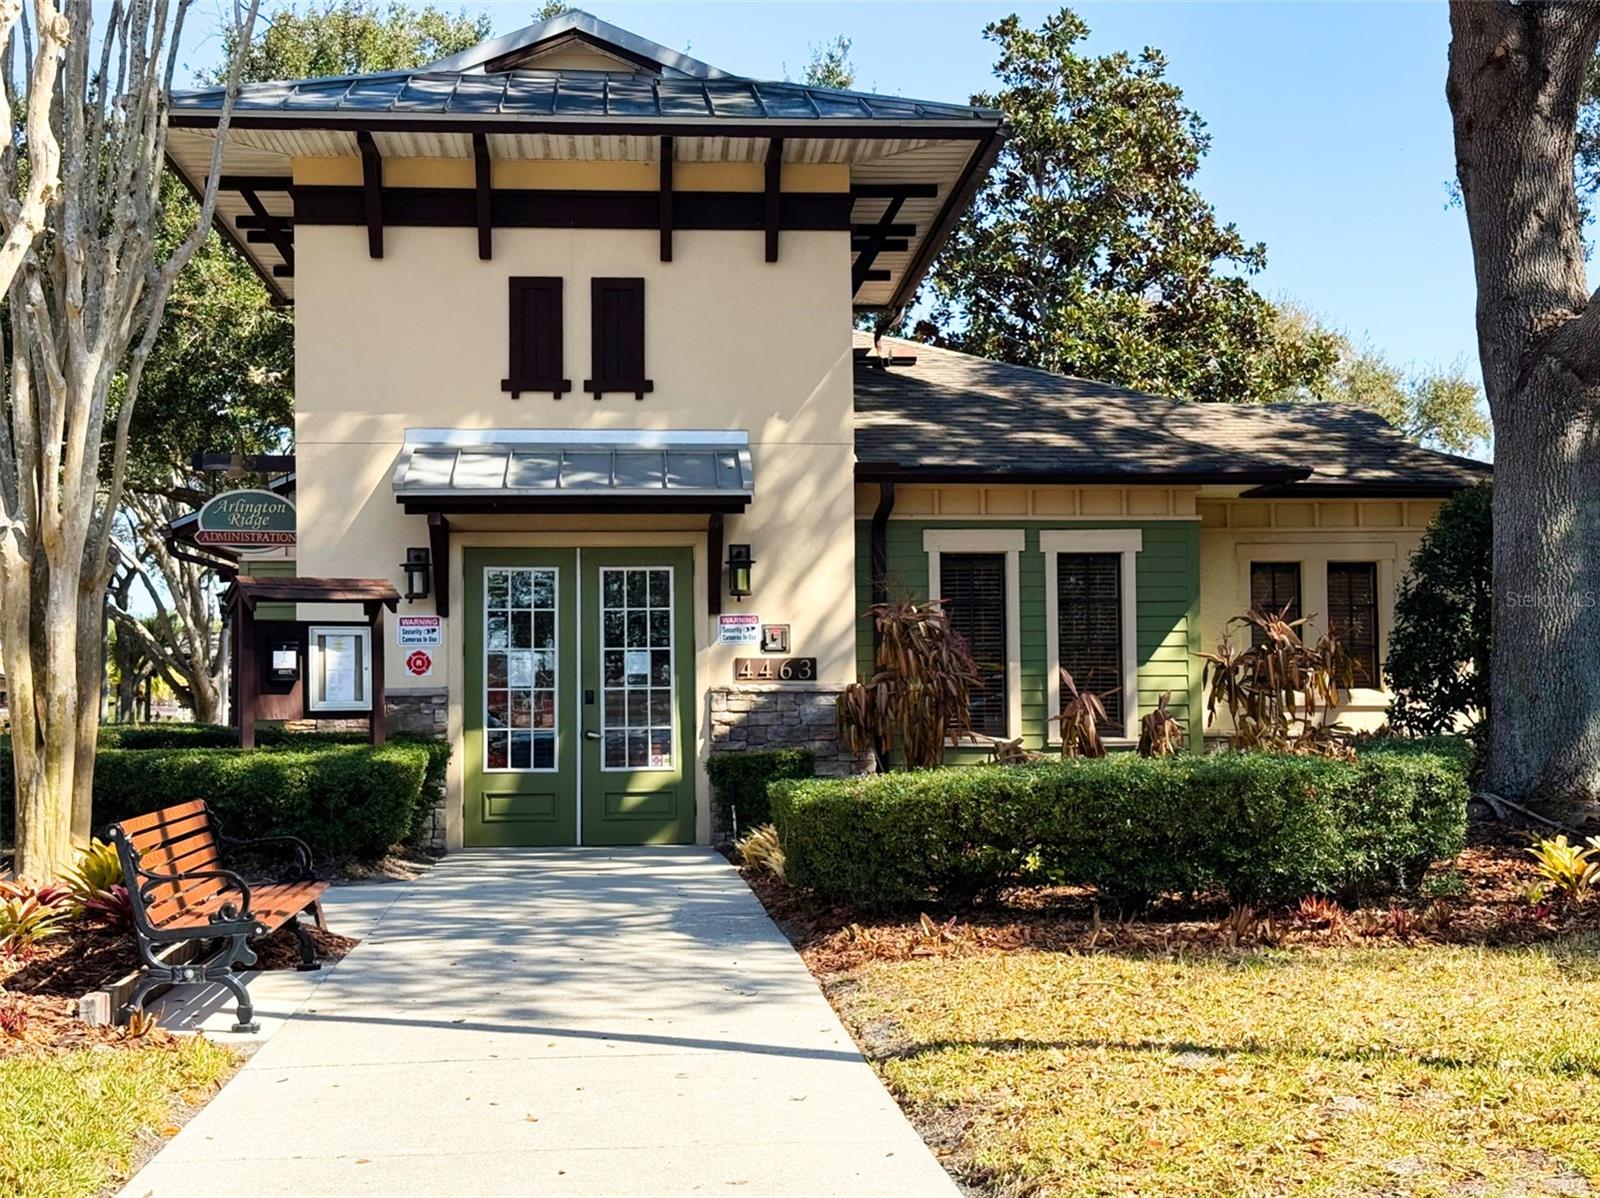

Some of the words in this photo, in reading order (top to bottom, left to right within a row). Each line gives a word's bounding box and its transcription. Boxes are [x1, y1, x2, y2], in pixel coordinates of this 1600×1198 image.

[213, 498, 286, 516] Arlington
[228, 512, 270, 529] Ridge
[202, 533, 296, 542] ADMINISTRATION
[722, 616, 757, 624] WARNING
[722, 626, 742, 634] Security
[738, 659, 811, 679] 4463
